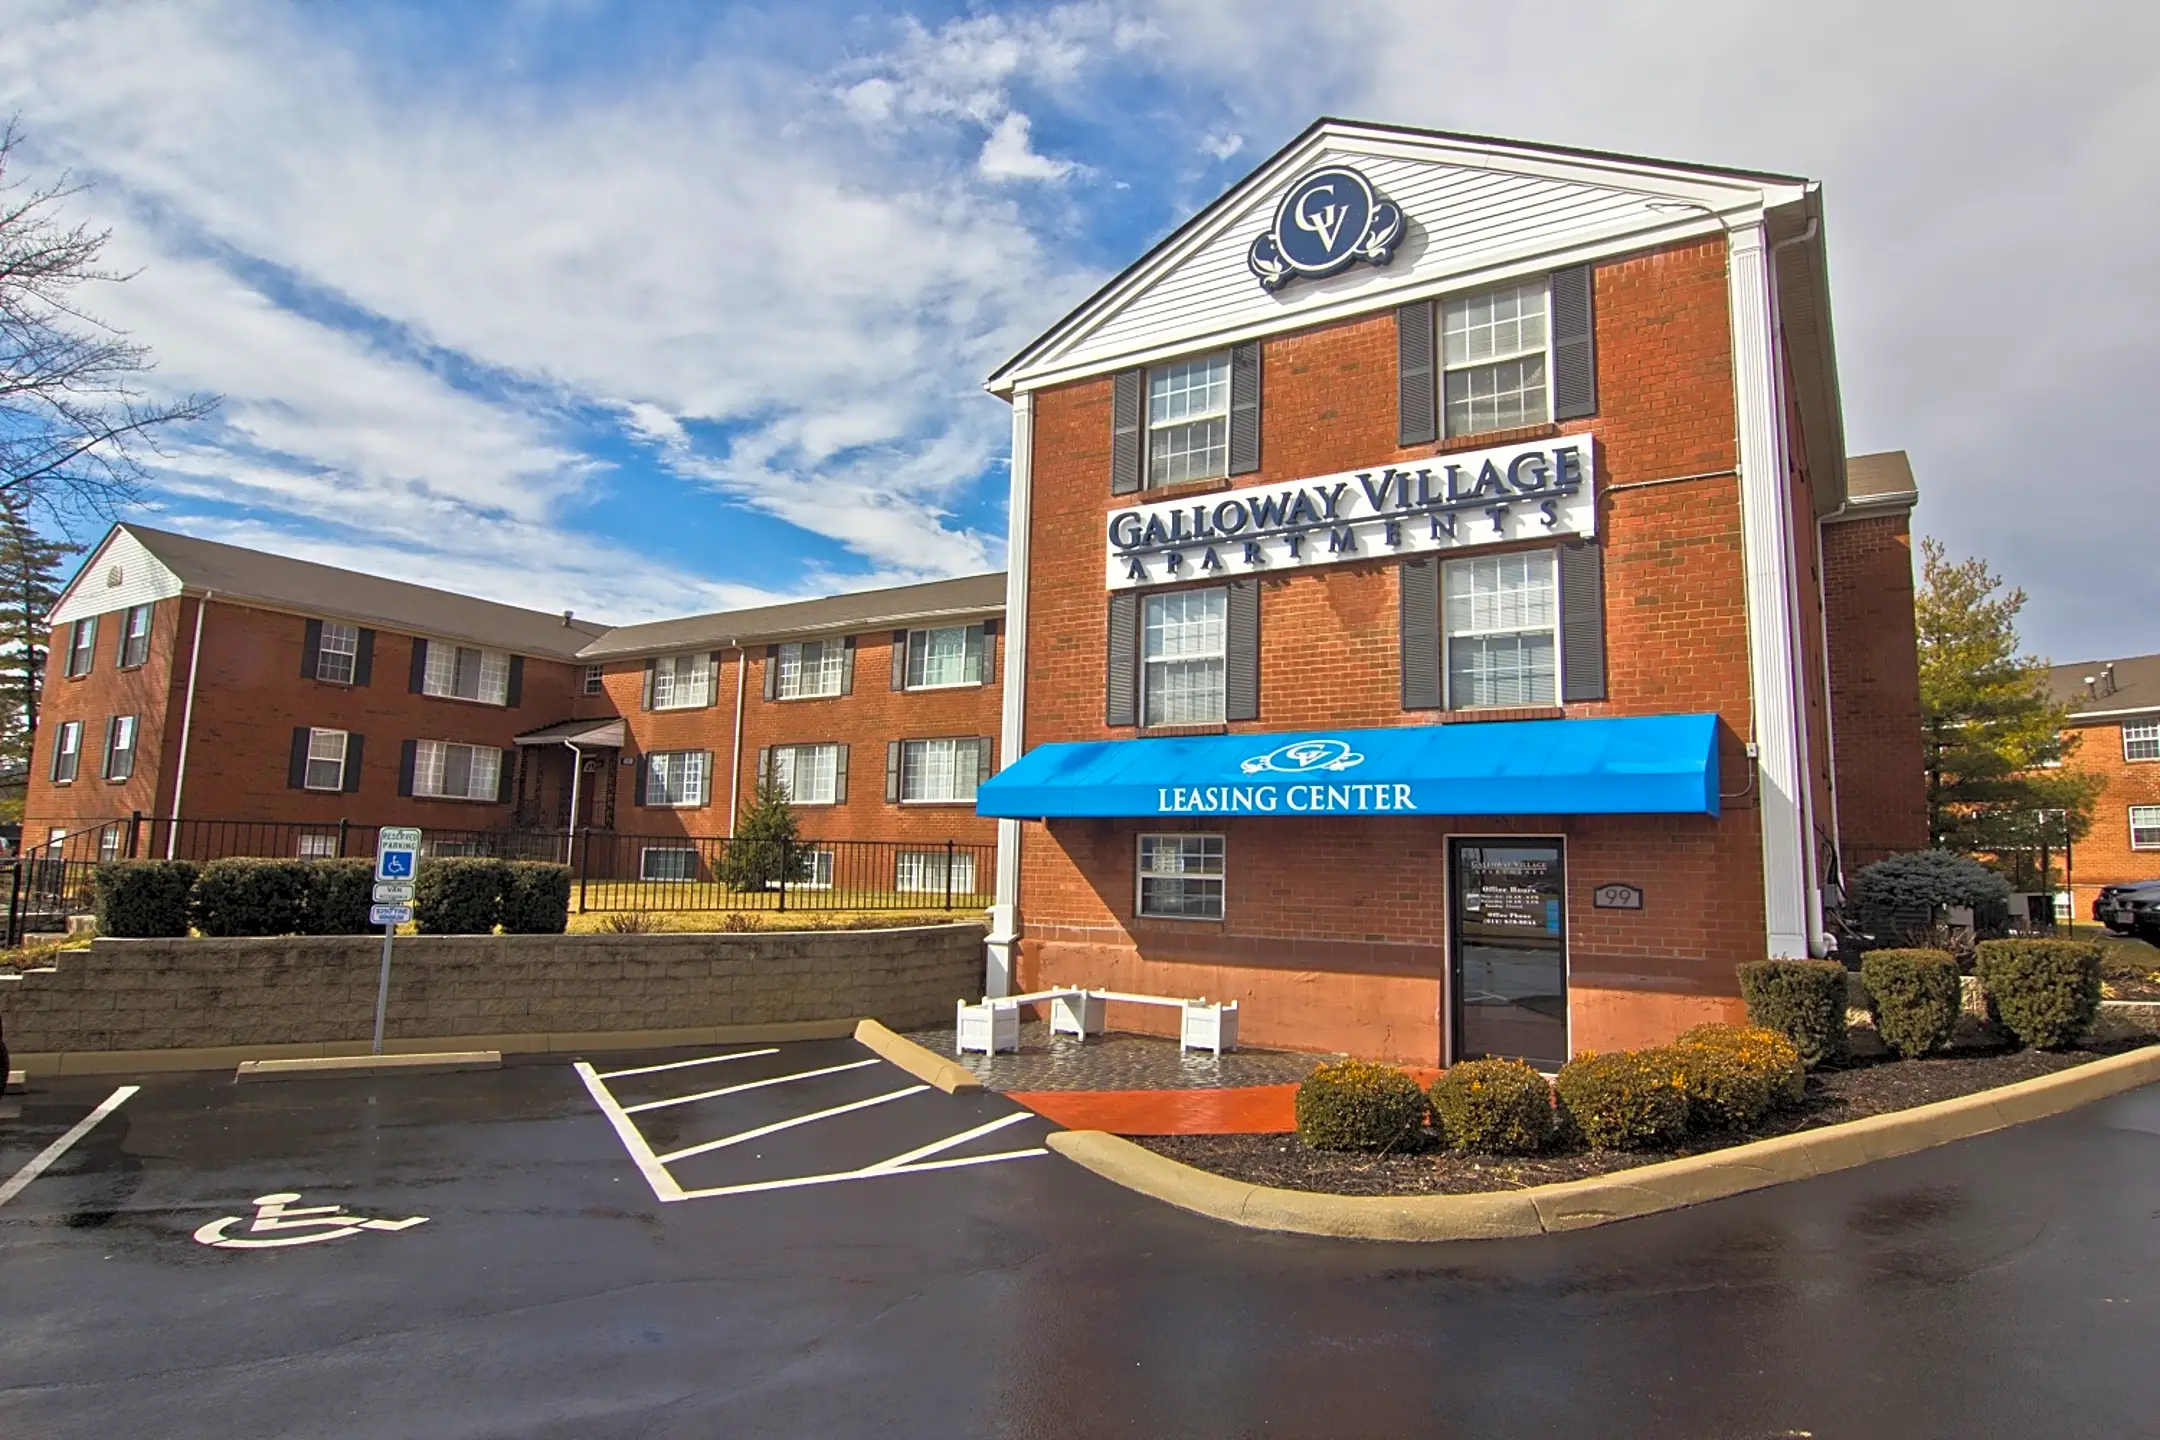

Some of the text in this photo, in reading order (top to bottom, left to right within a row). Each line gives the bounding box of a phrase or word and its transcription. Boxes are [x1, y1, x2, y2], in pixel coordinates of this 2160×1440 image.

[1109, 446, 1582, 549] GALLOWAY VILLAGE
[1126, 499, 1558, 580] APARTMENTS
[1158, 784, 1418, 812] LEASING CENTER
[383, 842, 416, 850] PARKING
[1605, 889, 1631, 905] 99
